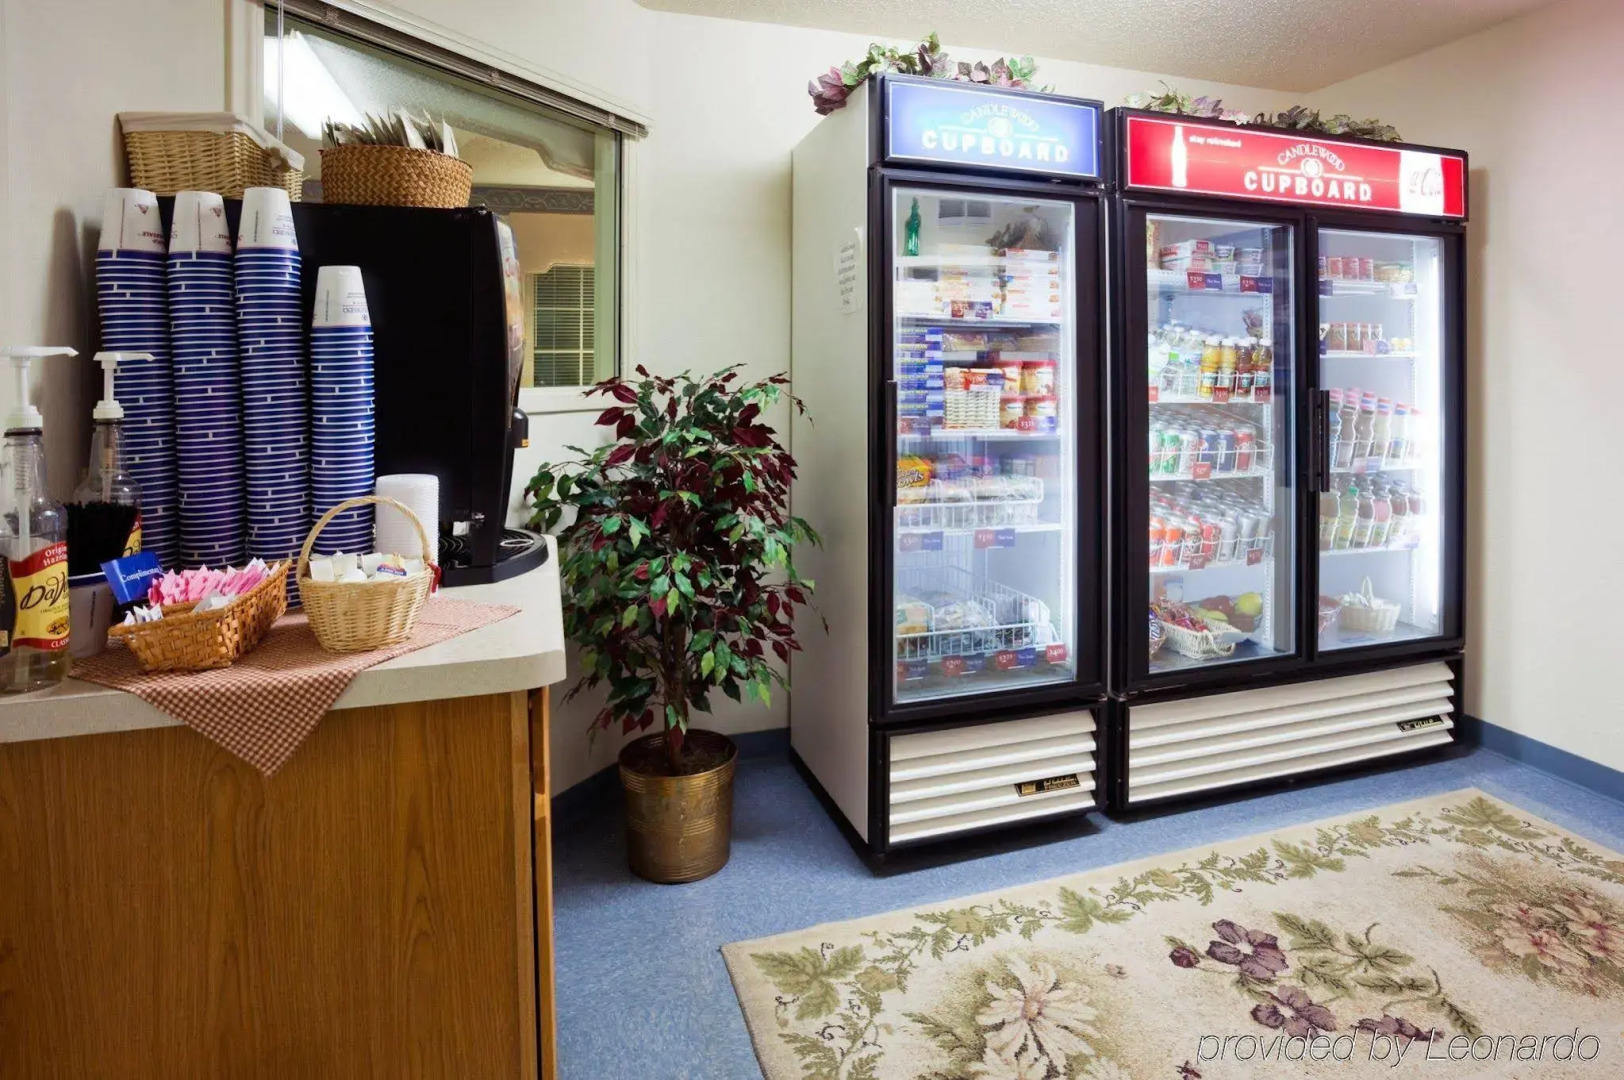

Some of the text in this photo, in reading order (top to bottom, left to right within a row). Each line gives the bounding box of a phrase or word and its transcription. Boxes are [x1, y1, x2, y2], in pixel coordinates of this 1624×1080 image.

[921, 129, 1069, 163] CUPBOARD
[1277, 144, 1345, 171] CANDLEWOOD
[1244, 171, 1371, 201] CUPBOARD
